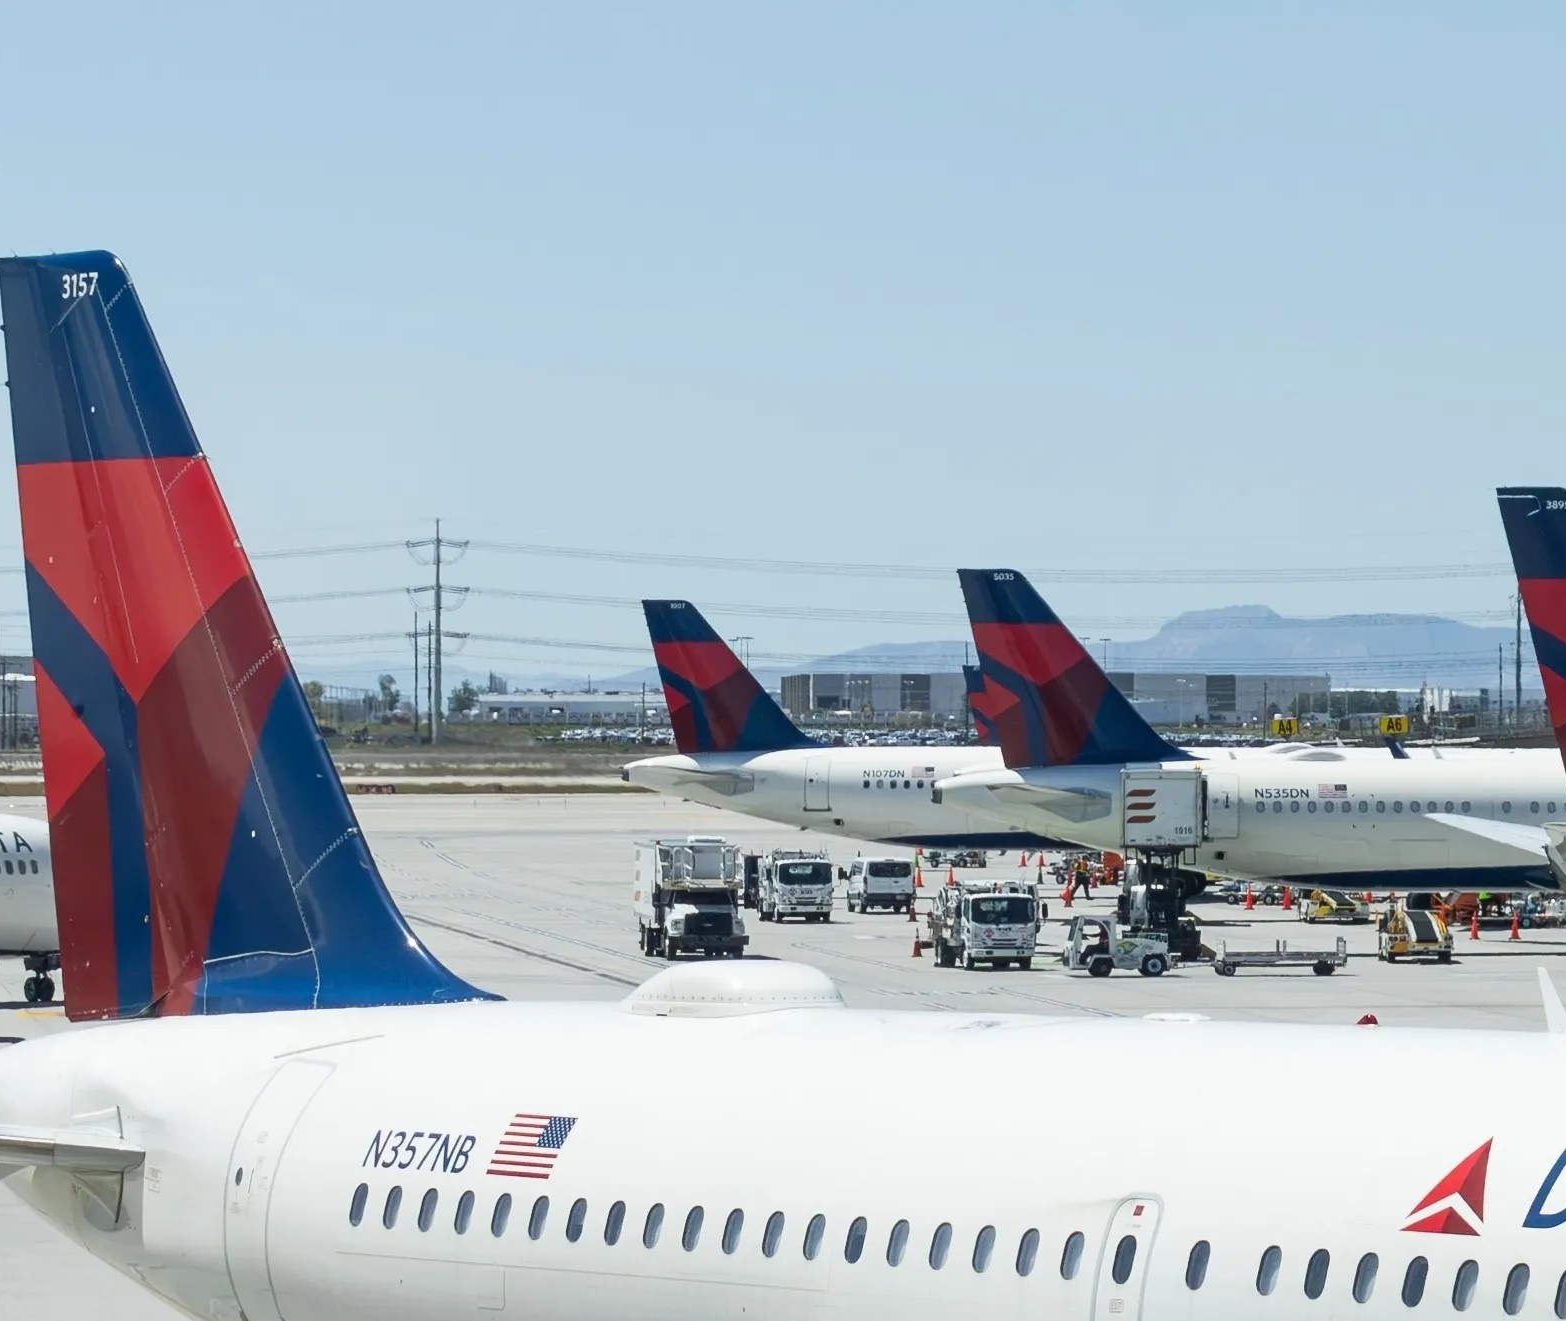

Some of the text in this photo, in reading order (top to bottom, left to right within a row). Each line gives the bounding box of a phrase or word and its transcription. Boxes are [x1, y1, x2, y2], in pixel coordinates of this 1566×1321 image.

[61, 271, 99, 299] 3157
[1278, 719, 1293, 735] A4
[1386, 719, 1402, 732] A6
[862, 769, 905, 778] N107DN
[1254, 788, 1310, 799] N535DN
[362, 1129, 477, 1174] N357NB
